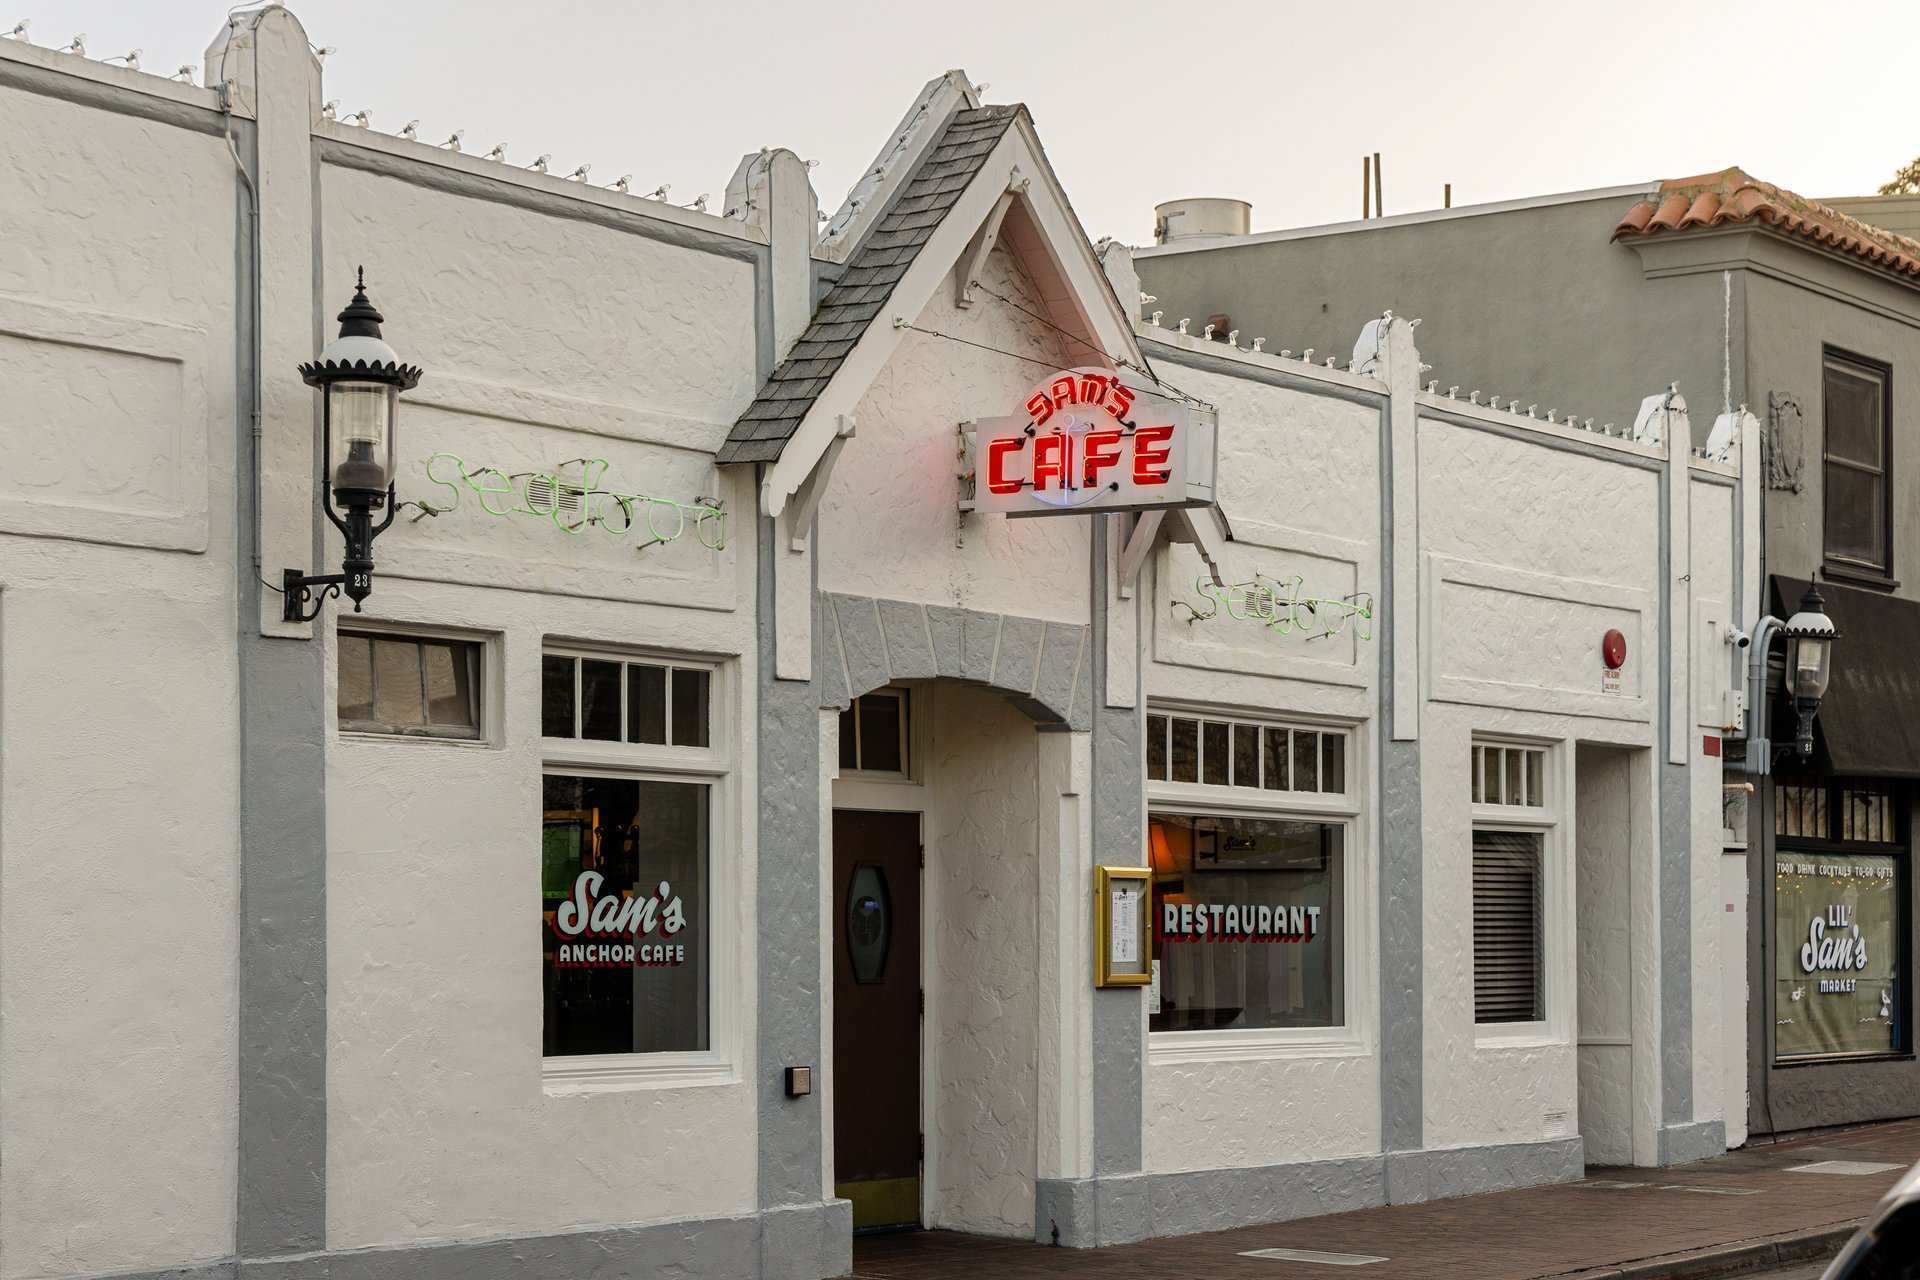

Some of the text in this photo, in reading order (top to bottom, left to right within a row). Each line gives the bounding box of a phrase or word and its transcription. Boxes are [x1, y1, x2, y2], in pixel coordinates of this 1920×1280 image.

[1025, 373, 1135, 426] SAM'S
[987, 424, 1175, 494] CAFE
[355, 574, 368, 587] 23
[1776, 862, 1794, 874] FOOD
[1797, 864, 1816, 875] DRINK
[1820, 864, 1851, 876] COCKTAILS
[1877, 867, 1894, 877] GIFTS
[554, 870, 687, 938] Sam's
[1828, 904, 1852, 927] LIL'
[1161, 903, 1321, 938] RESTAURANT
[558, 944, 684, 964] ANCHOR CAFE
[1801, 916, 1867, 974] Sam's
[1820, 978, 1856, 993] MARKET
